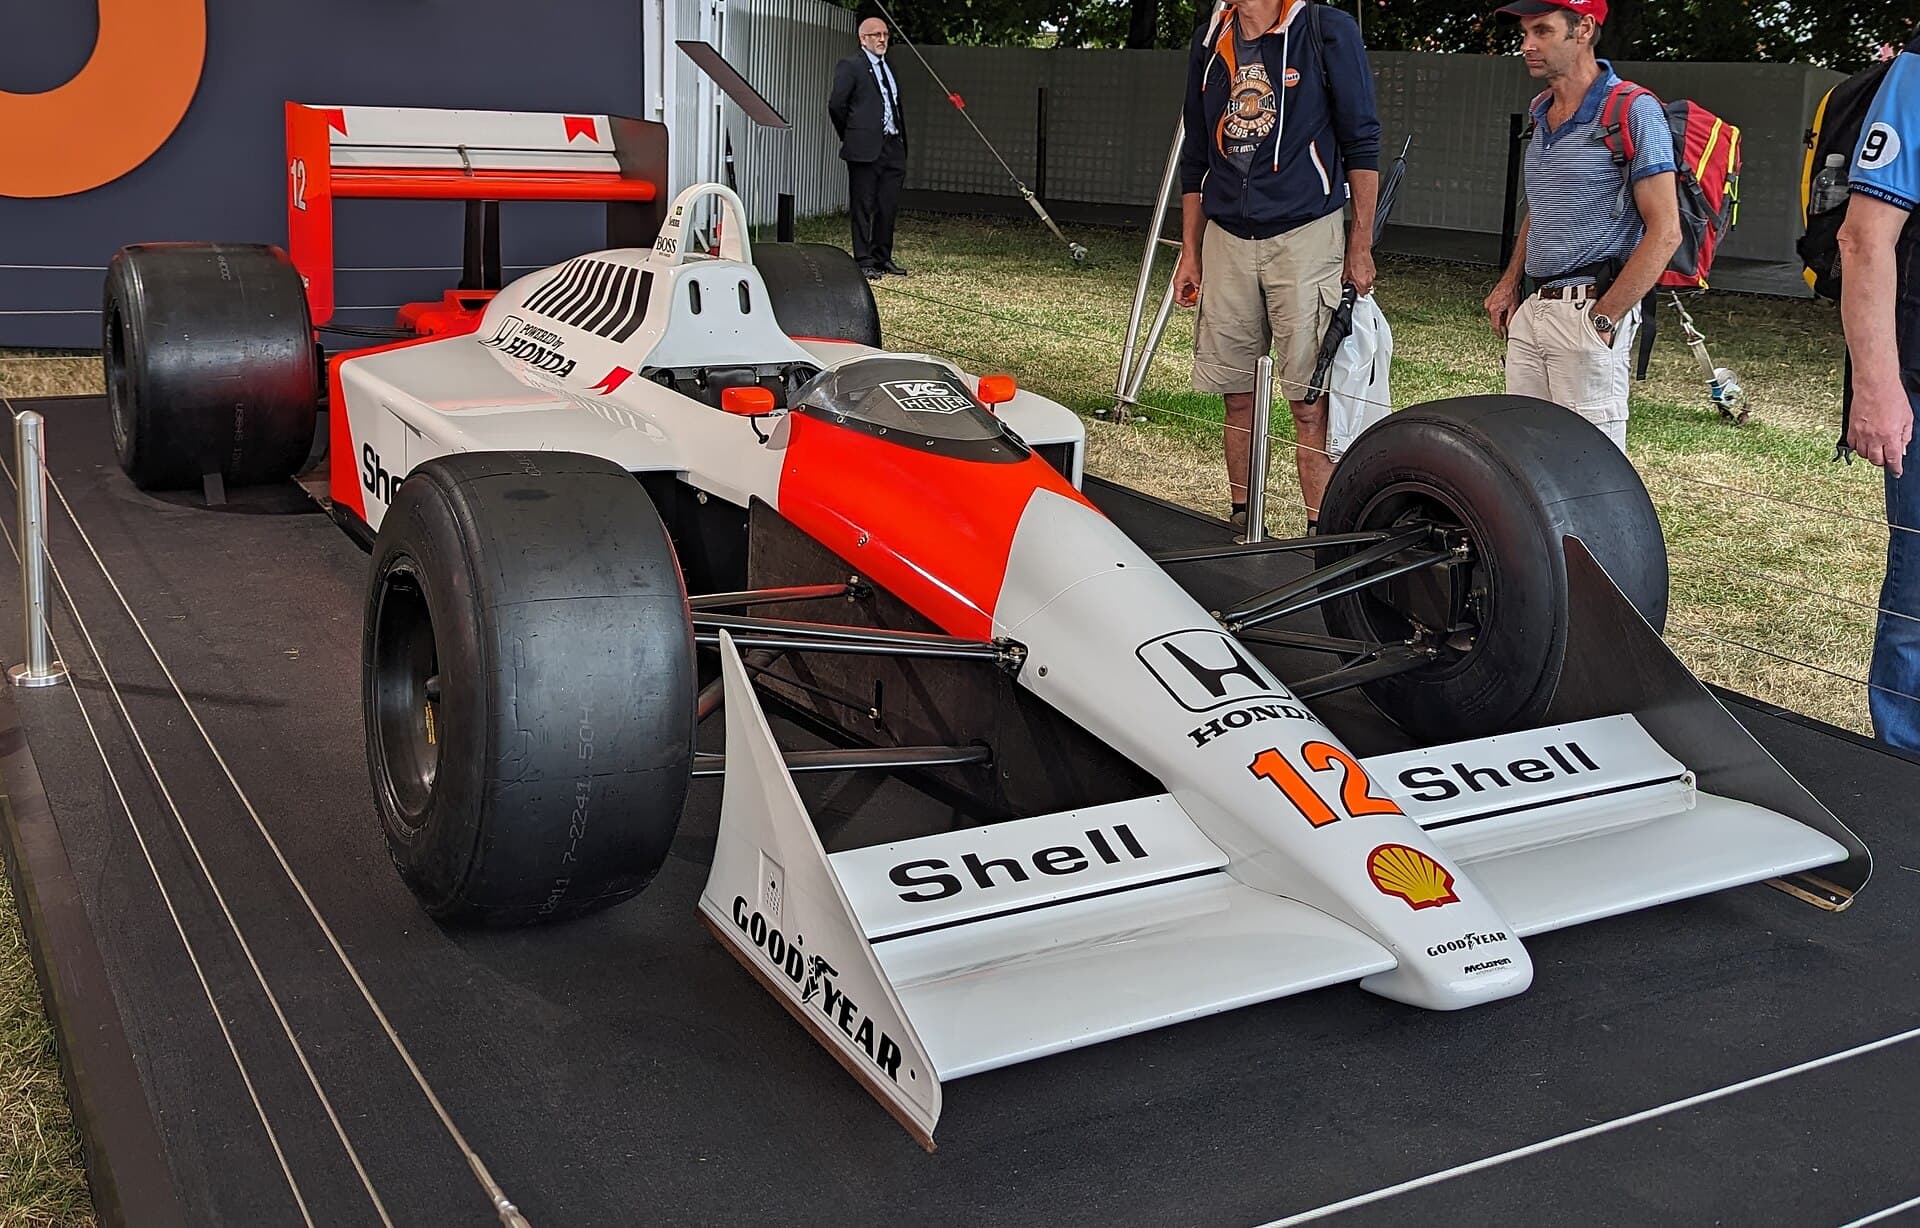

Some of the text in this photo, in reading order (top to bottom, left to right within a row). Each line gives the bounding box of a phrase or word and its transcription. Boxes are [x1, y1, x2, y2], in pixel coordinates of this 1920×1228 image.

[1227, 122, 1249, 138] 1995
[1861, 129, 1888, 162] 9
[291, 159, 306, 211] 12
[656, 236, 677, 254] BOSS
[520, 323, 558, 345] POWERED
[499, 336, 577, 378] HONDA
[904, 397, 969, 411] HEUER
[1247, 740, 1408, 829] 12
[1398, 742, 1601, 803] Shell
[888, 824, 1150, 903] Shell
[1463, 957, 1512, 974] McLaren
